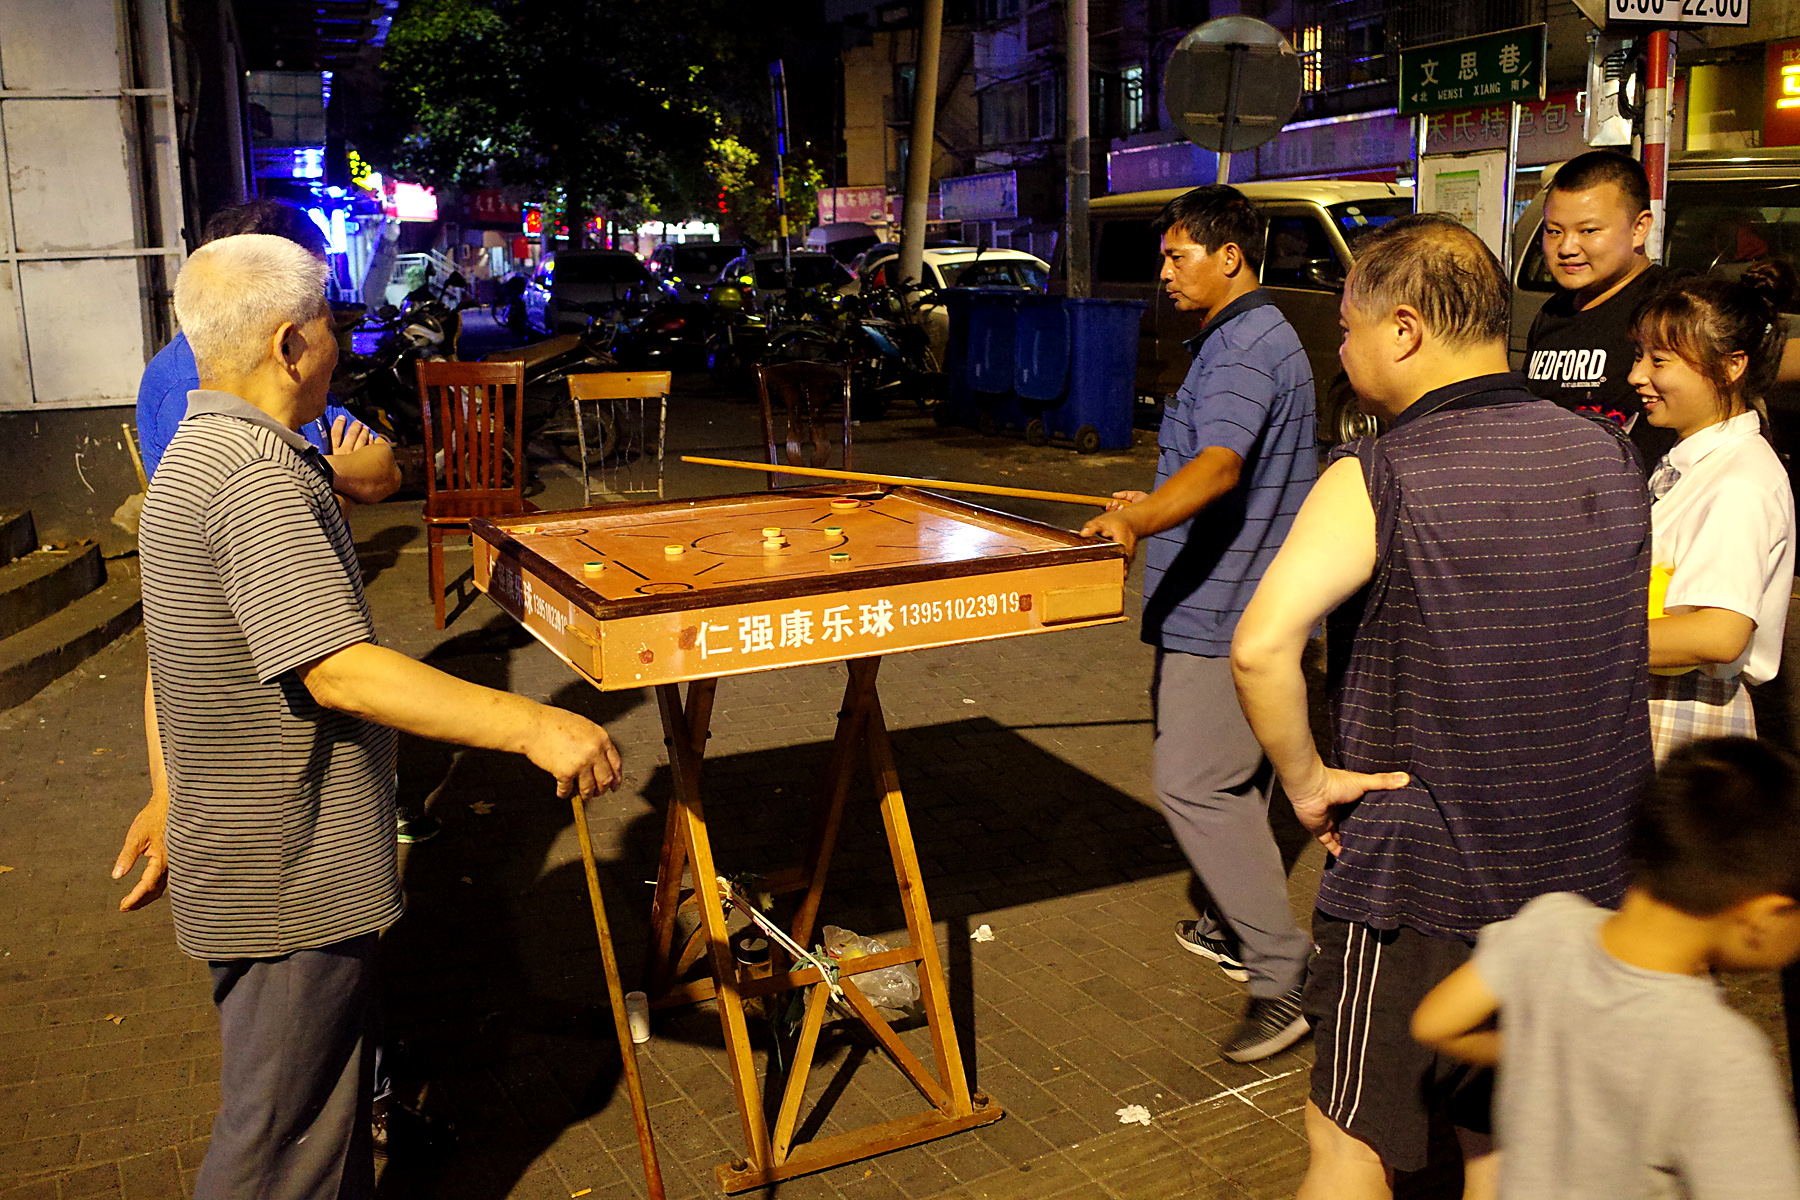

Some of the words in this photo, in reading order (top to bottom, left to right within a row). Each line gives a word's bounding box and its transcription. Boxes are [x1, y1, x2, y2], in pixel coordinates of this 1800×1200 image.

[1420, 43, 1520, 86] 文思巷
[1420, 91, 1428, 102] 北
[1437, 87, 1463, 101] WENSI
[1473, 82, 1501, 97] XIANG
[1511, 79, 1520, 92] 南
[695, 598, 895, 660] 仁强康乐球
[899, 591, 1020, 627] 13951023919
